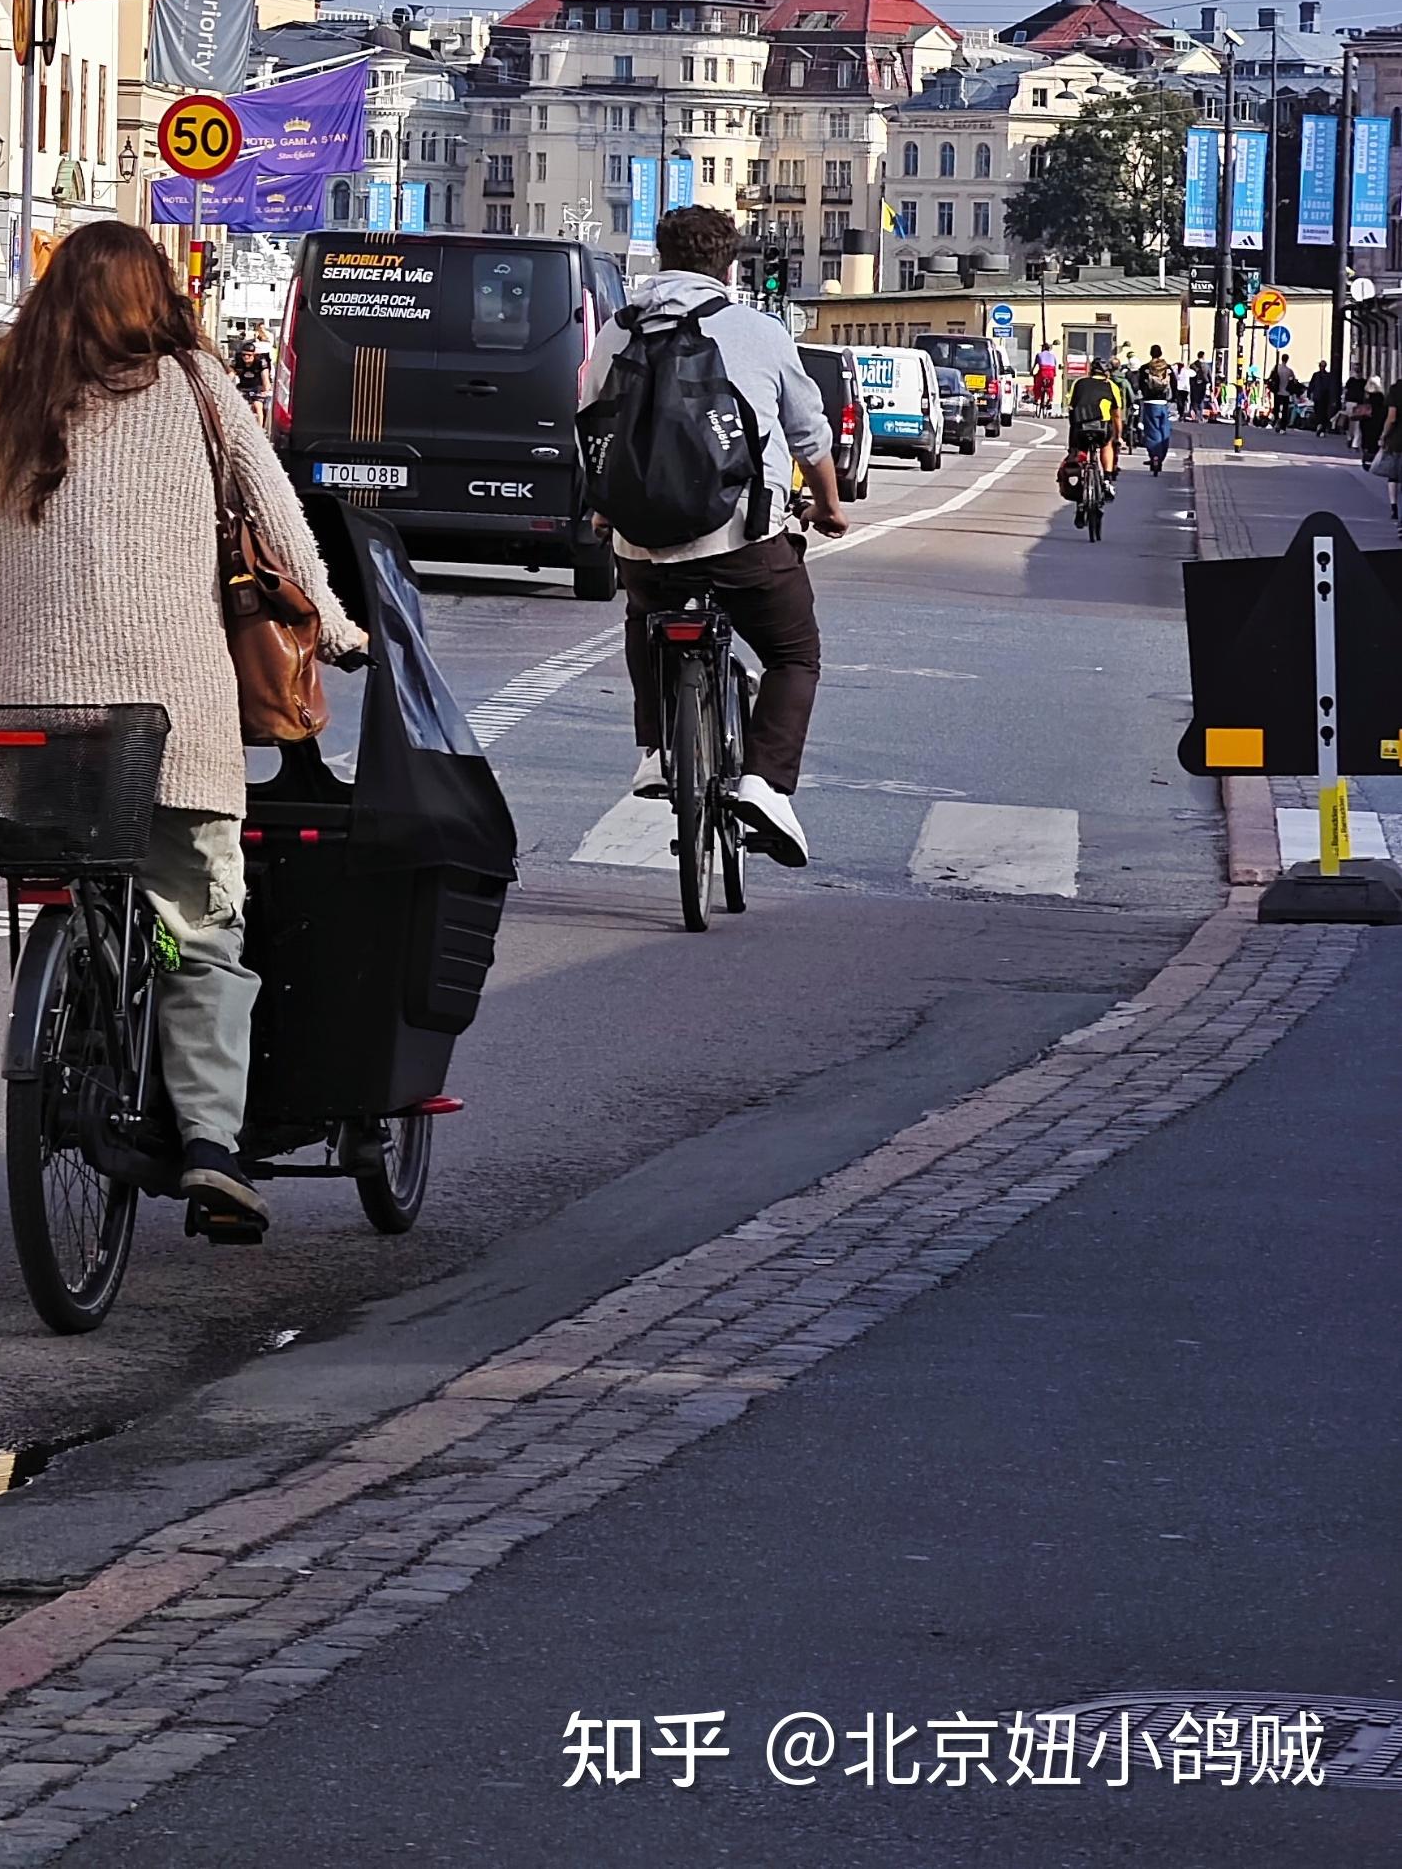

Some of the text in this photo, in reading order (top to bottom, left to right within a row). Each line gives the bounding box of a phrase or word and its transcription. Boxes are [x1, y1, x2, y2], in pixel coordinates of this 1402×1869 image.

[173, 116, 229, 158] 50
[280, 136, 317, 146] GAMLA
[321, 133, 349, 144] STAN
[324, 253, 405, 267] E-MOBILITY
[322, 267, 434, 283] SERVICE PÅ VÄG
[320, 293, 416, 306] LADDBOXAR OCH
[319, 305, 431, 319] SYSTEMLÖSNINGAR
[328, 466, 400, 483] TOL 08B
[468, 481, 534, 498] CTEK
